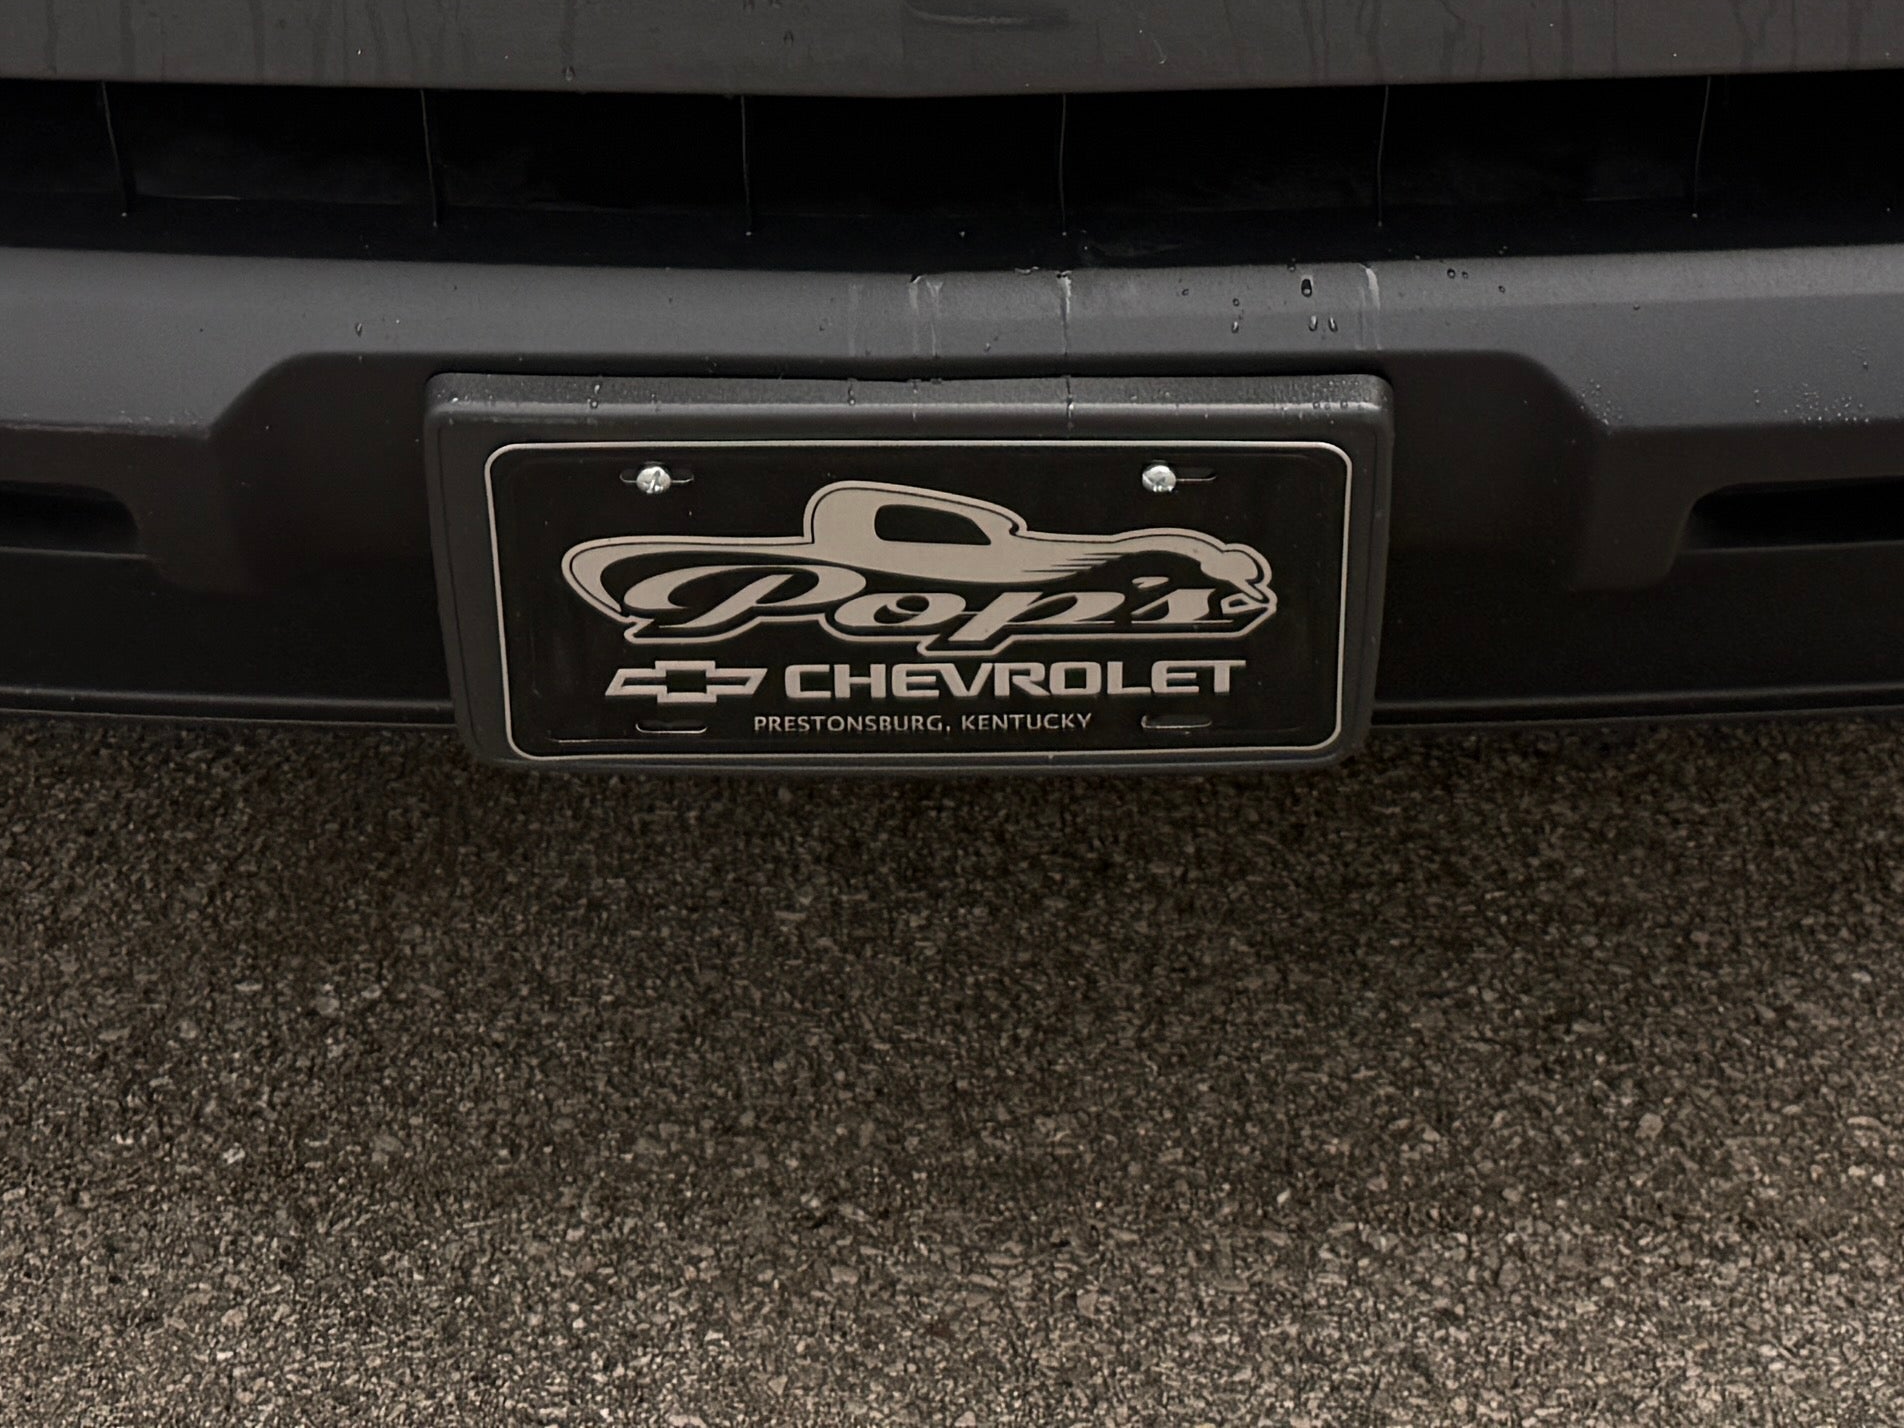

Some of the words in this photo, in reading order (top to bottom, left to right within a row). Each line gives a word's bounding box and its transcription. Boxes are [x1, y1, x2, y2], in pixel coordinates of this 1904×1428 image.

[620, 561, 1236, 644] Pop's
[784, 660, 1246, 699] CHEVROLET
[754, 715, 951, 732] PRESTONSBURG,
[961, 712, 1092, 731] KENTUCKY
